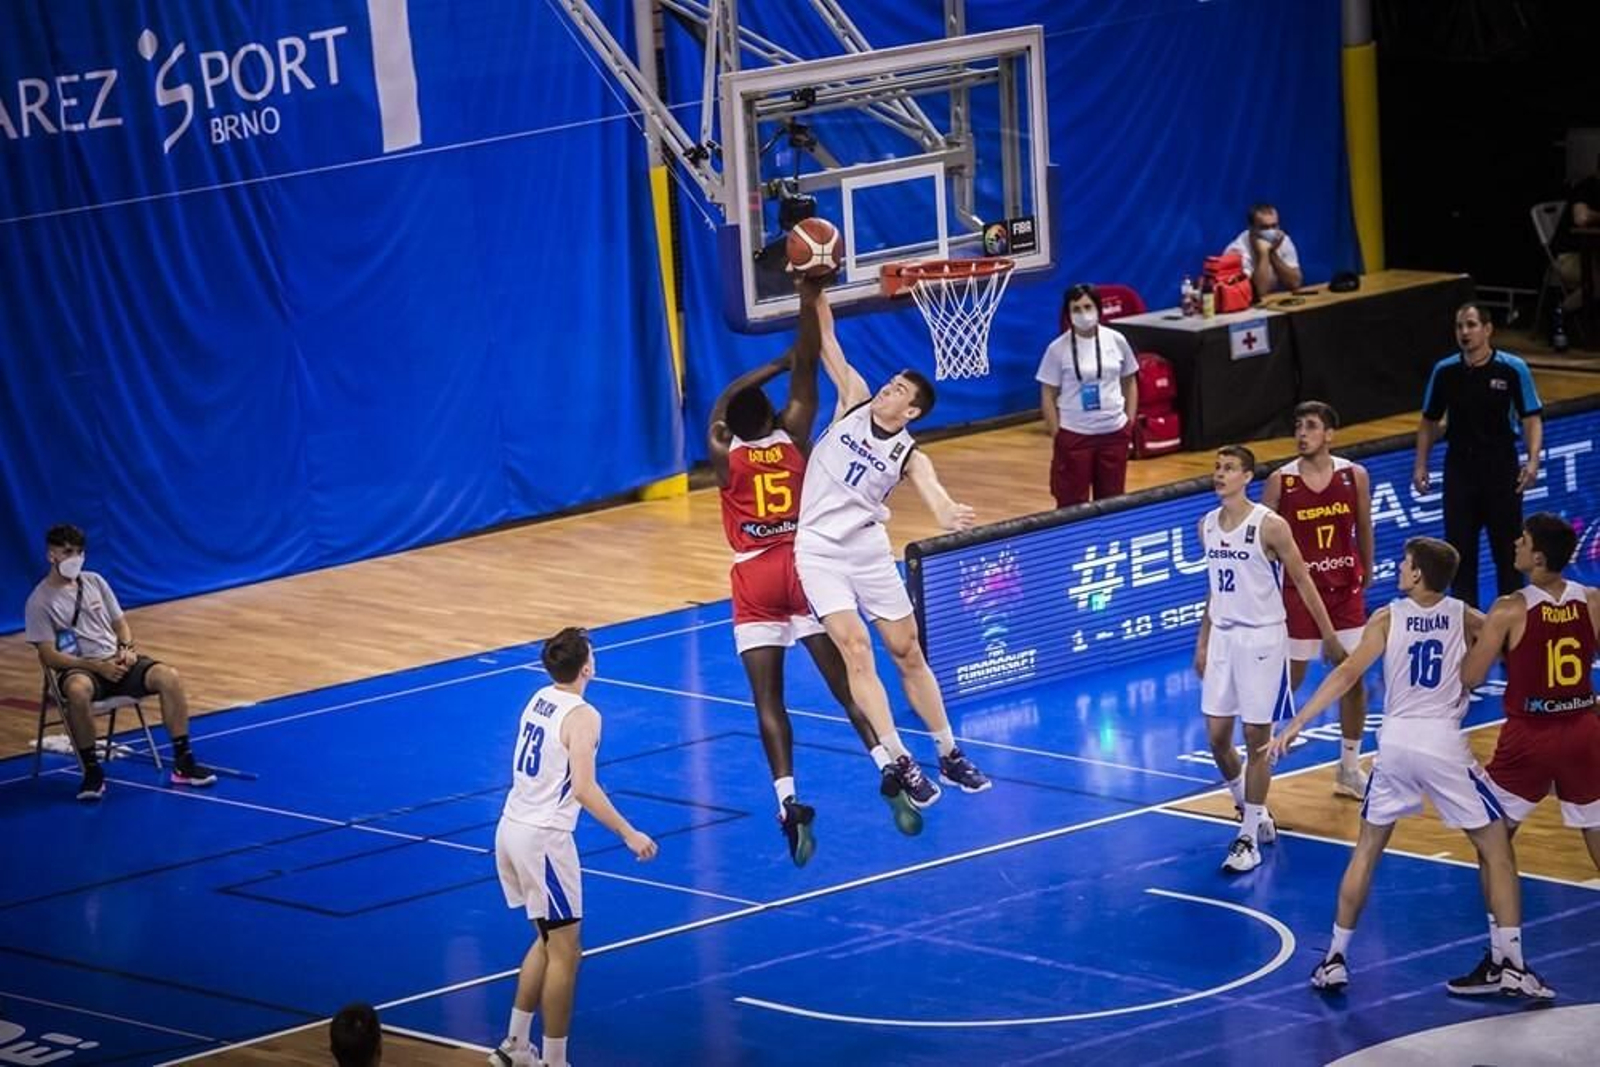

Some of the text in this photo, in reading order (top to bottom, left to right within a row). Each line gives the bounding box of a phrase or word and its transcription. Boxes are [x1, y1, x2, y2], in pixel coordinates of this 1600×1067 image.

[155, 26, 348, 154] SPORT
[210, 106, 281, 145] BRNO
[844, 460, 868, 487] 17
[753, 470, 793, 517] 15
[1297, 502, 1350, 520] ESPAÑA
[1208, 548, 1250, 560] ČESKO
[1317, 525, 1335, 549] 17
[1406, 613, 1450, 633] PELIKÁN
[1408, 638, 1444, 689] 16
[1546, 637, 1583, 688] 16
[516, 721, 545, 777] 73
